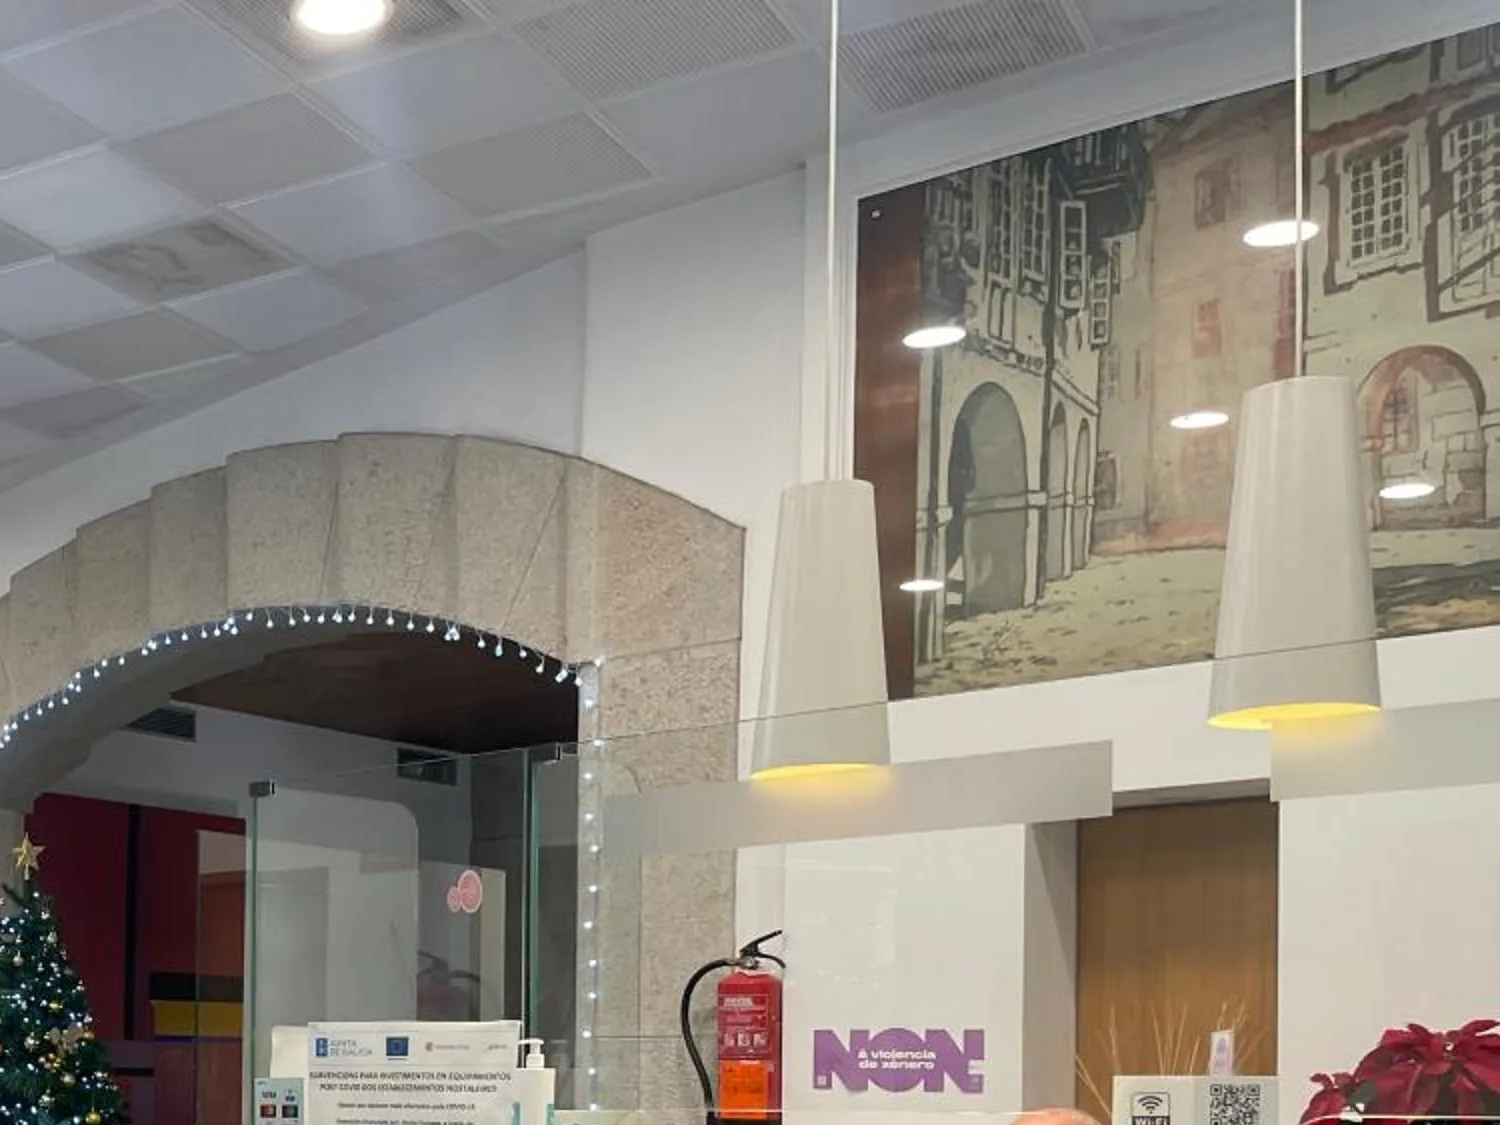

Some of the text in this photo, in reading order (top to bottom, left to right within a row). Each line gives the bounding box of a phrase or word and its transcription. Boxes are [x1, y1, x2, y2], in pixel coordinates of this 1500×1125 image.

[871, 1048, 937, 1060] violencia
[813, 1028, 985, 1093] NON
[858, 1060, 879, 1070] de
